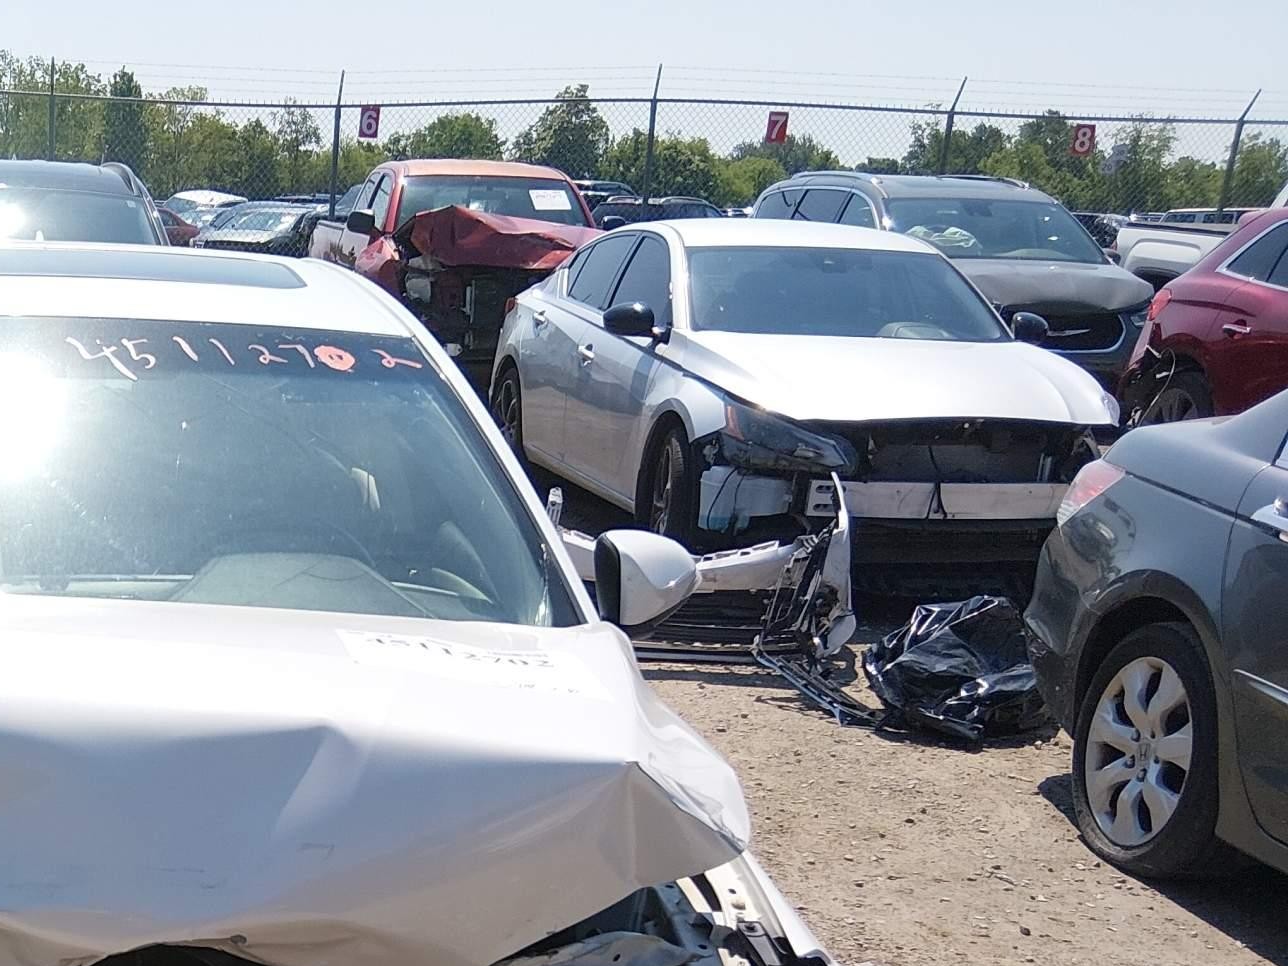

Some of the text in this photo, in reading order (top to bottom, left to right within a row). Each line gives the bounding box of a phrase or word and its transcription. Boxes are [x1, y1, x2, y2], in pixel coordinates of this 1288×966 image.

[361, 110, 377, 135] 6
[770, 114, 787, 140] 7
[1074, 127, 1092, 153] 8
